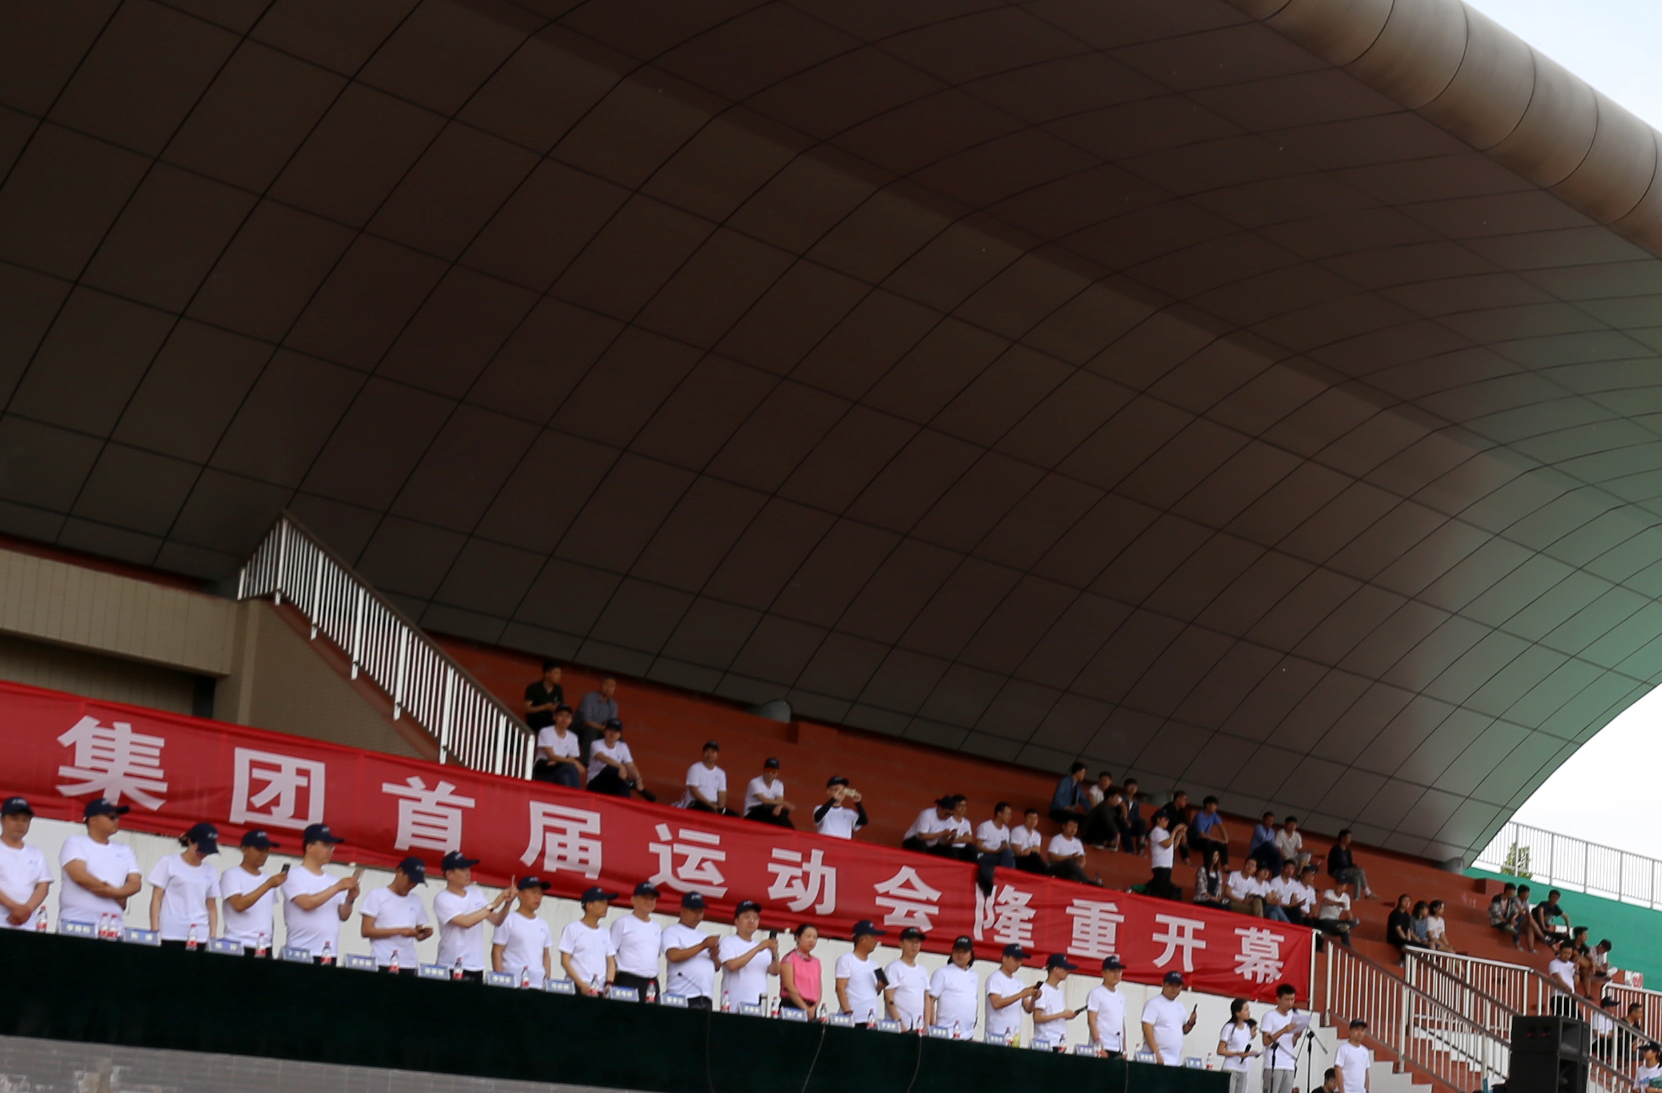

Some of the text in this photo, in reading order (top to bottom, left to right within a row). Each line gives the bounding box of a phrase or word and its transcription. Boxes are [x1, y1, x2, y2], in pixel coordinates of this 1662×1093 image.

[56, 715, 1286, 985] 集团首届运动会隆重开幕
